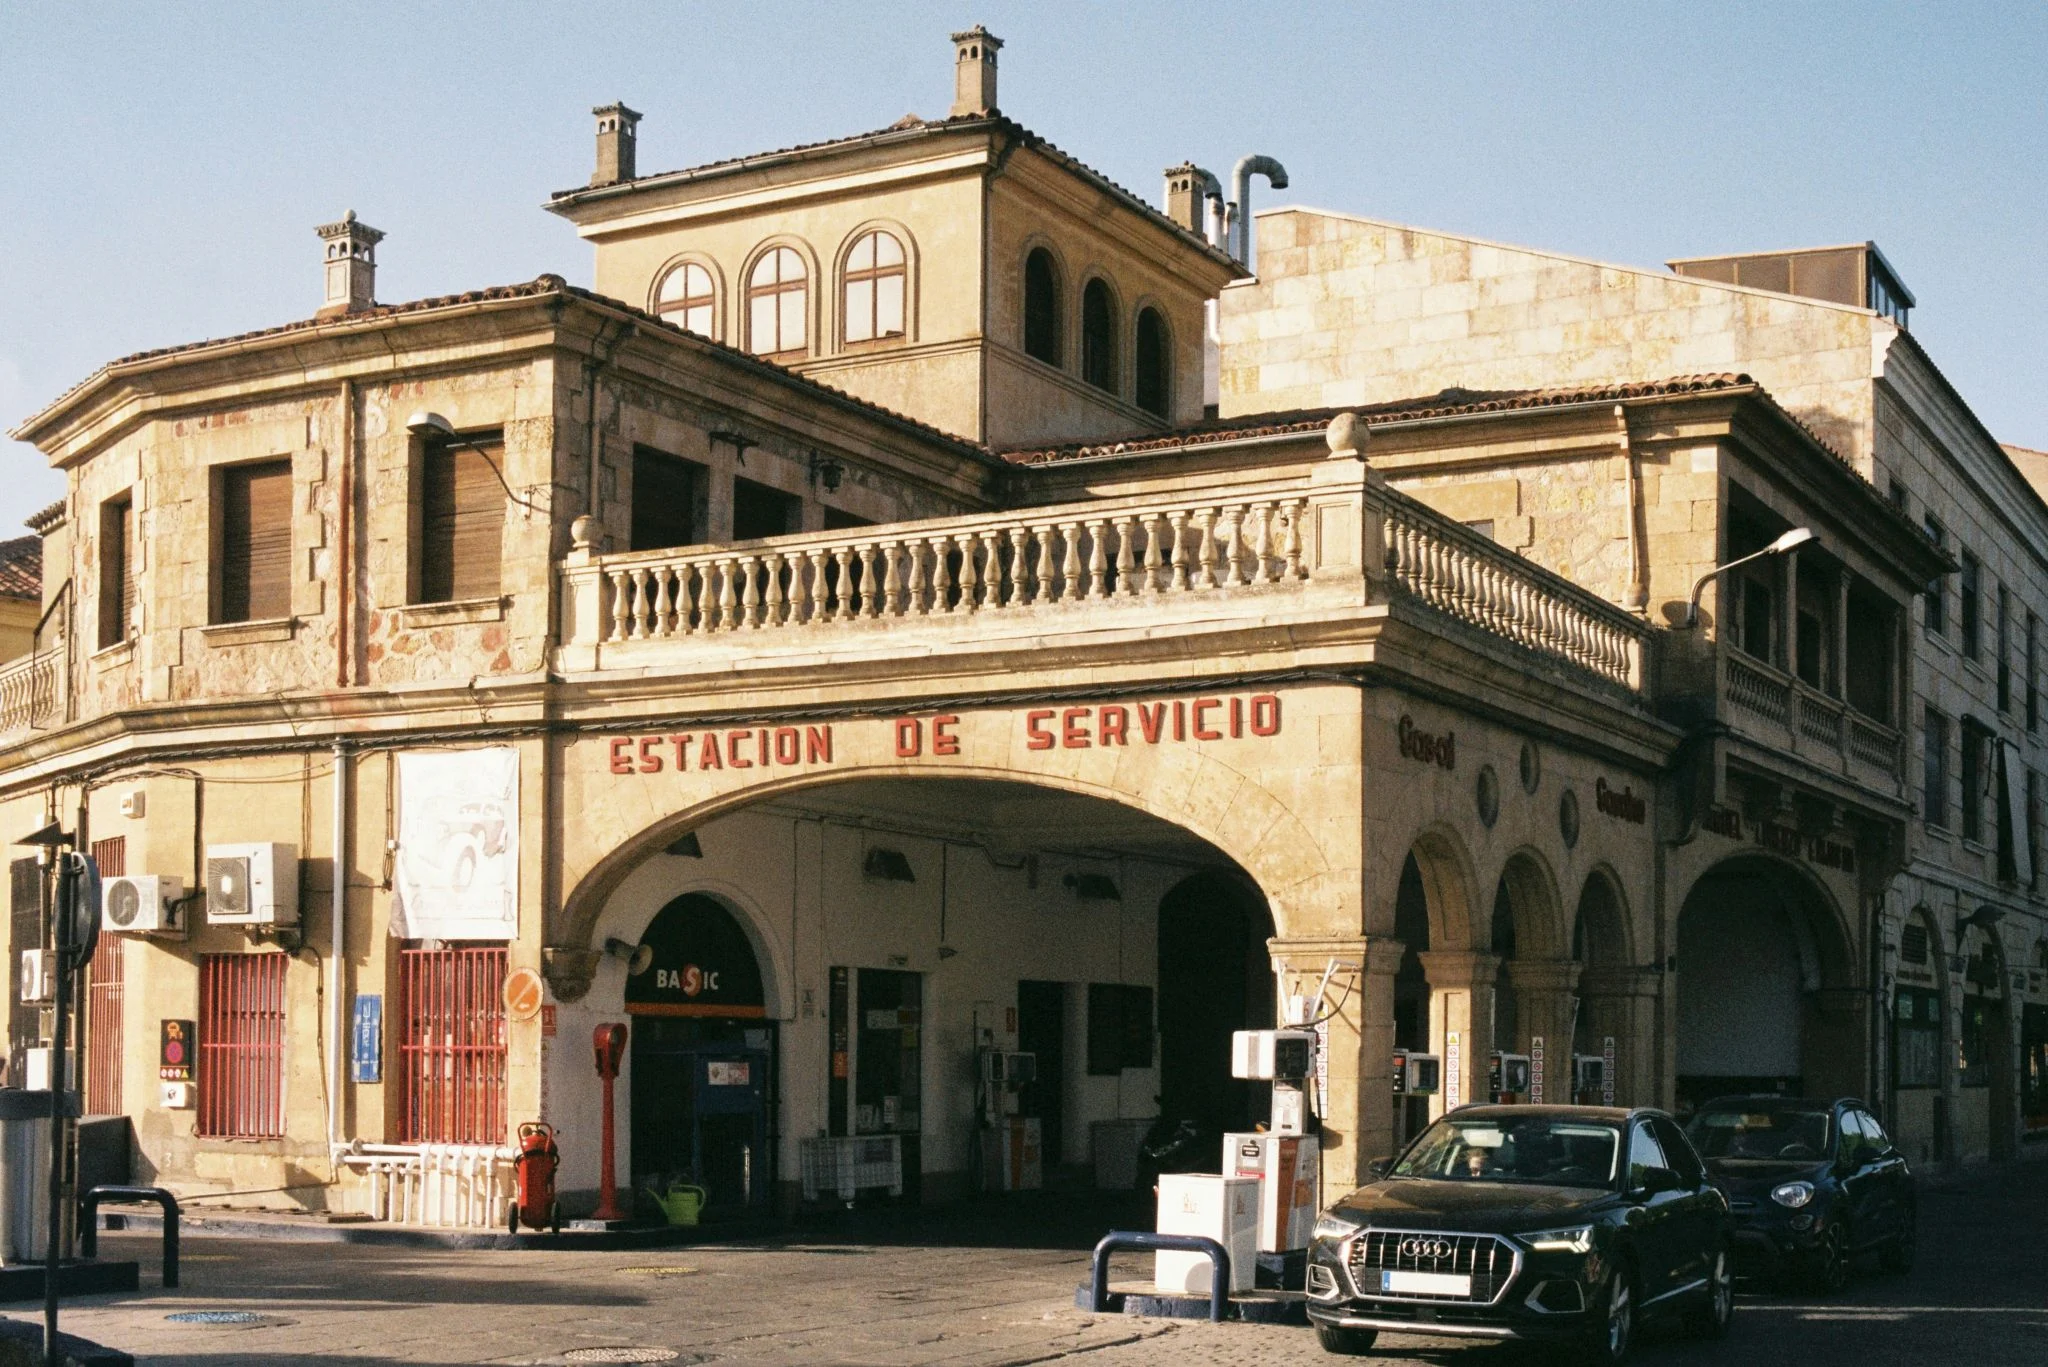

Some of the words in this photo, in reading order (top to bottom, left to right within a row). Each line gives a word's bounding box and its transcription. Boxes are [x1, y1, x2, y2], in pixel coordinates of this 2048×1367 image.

[609, 724, 832, 774] ESTACION
[895, 716, 960, 758] DE
[1027, 695, 1281, 750] SERVICIO
[656, 966, 719, 995] BASIC
